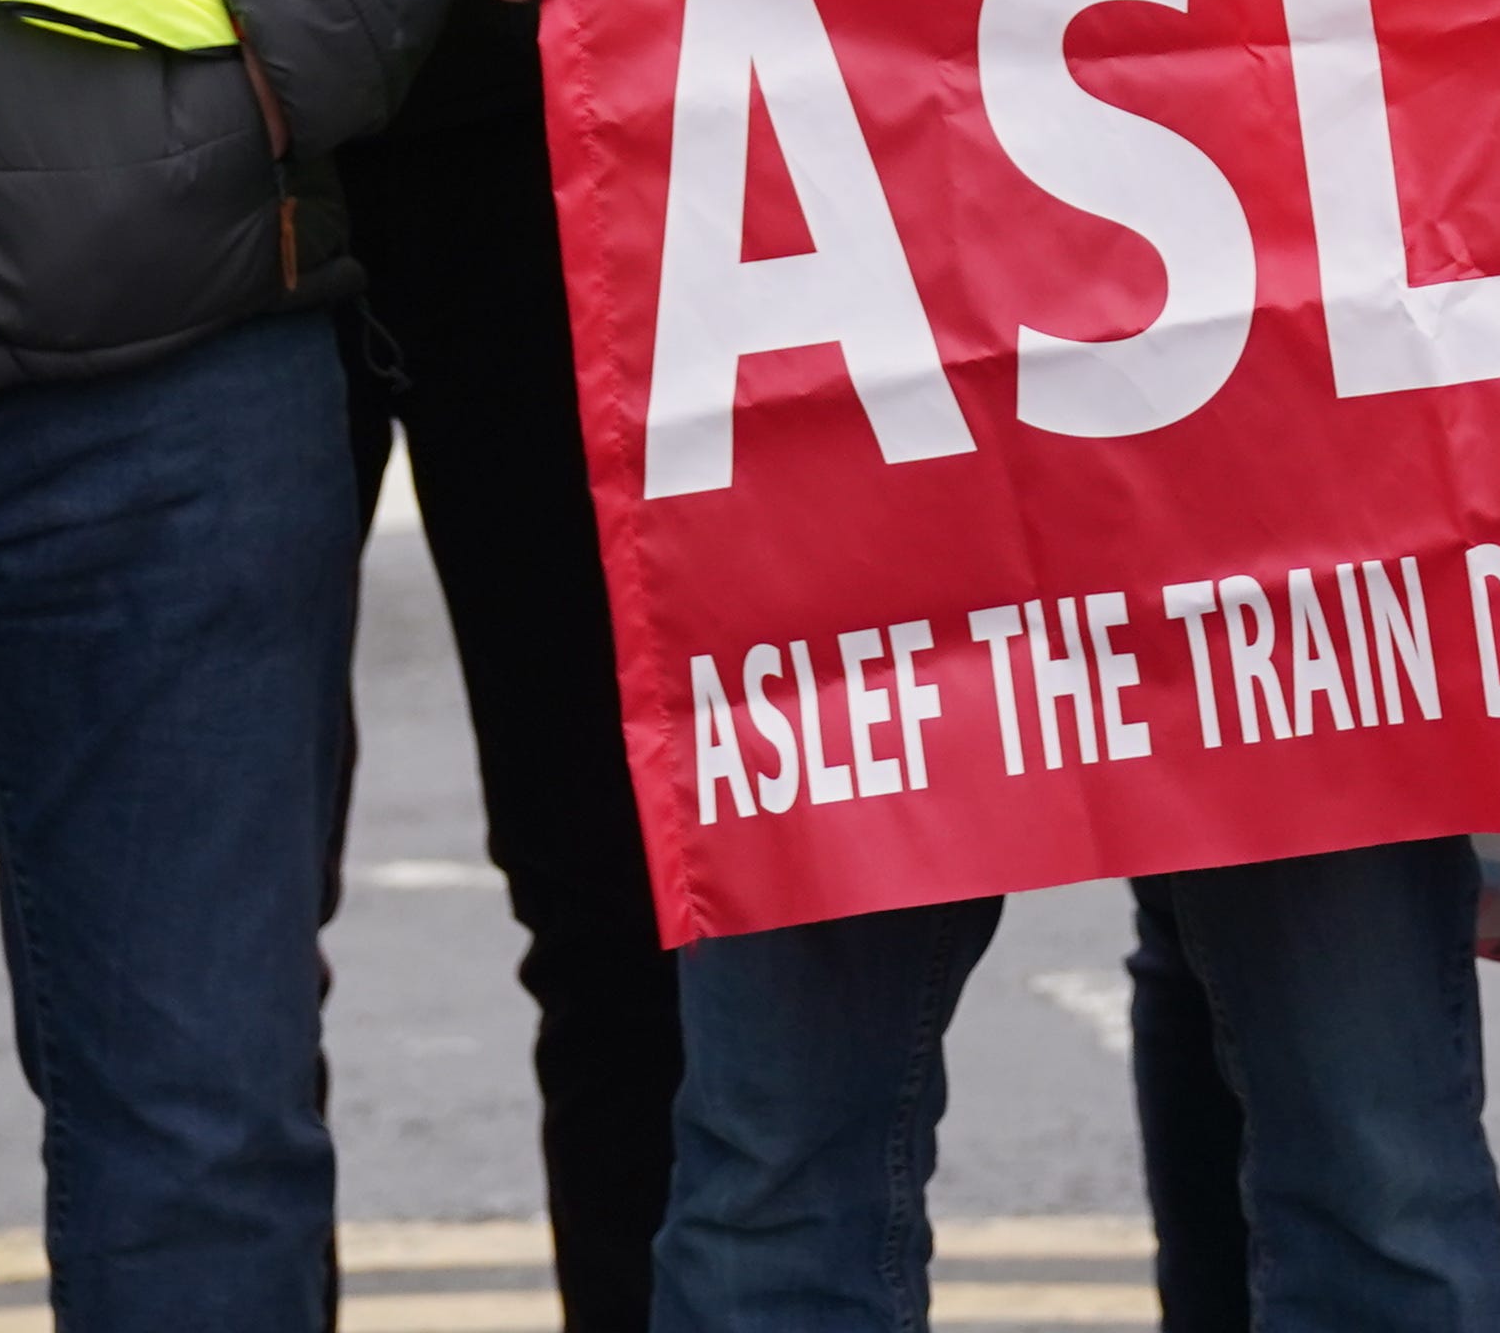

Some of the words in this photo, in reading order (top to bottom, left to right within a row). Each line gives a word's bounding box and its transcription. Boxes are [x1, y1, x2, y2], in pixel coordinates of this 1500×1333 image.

[691, 620, 941, 825] ASLEF
[969, 592, 1151, 776] THE
[1163, 557, 1441, 748] TRAIN
